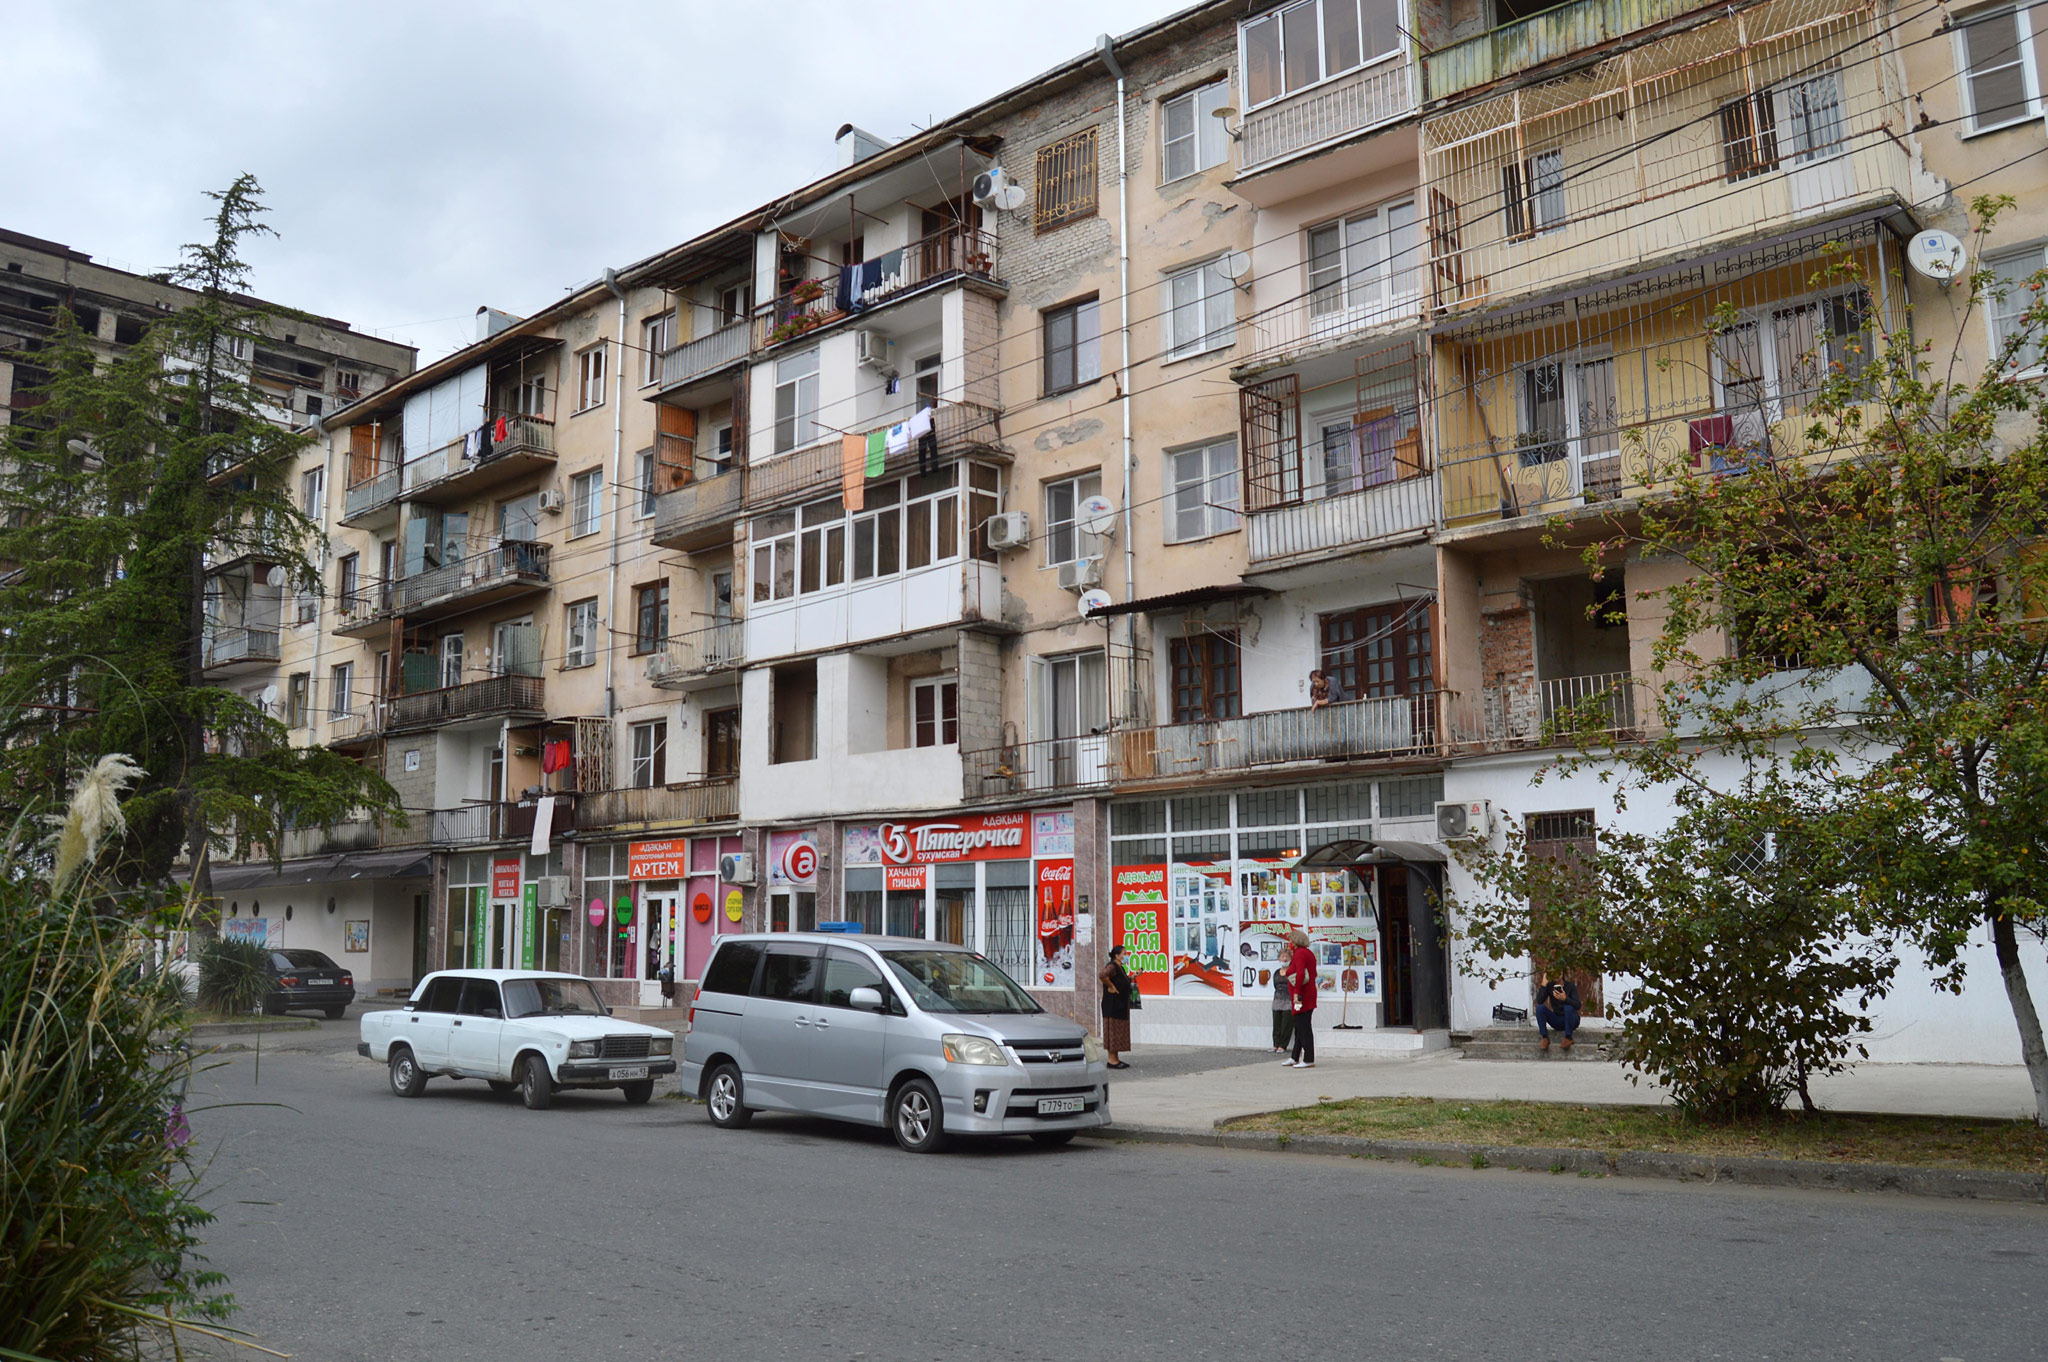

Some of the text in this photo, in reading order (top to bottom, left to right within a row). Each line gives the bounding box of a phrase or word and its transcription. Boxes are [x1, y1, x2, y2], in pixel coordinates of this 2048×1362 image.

[910, 823, 1024, 855] Пятерочка
[917, 850, 960, 862] сухумская
[633, 861, 680, 877] АРТЕМ
[892, 877, 921, 888] ПИЦЦА
[1124, 911, 1157, 931] ВСЕ
[1251, 923, 1293, 934] ПОСУДА
[1124, 932, 1160, 953] ДЛЯ
